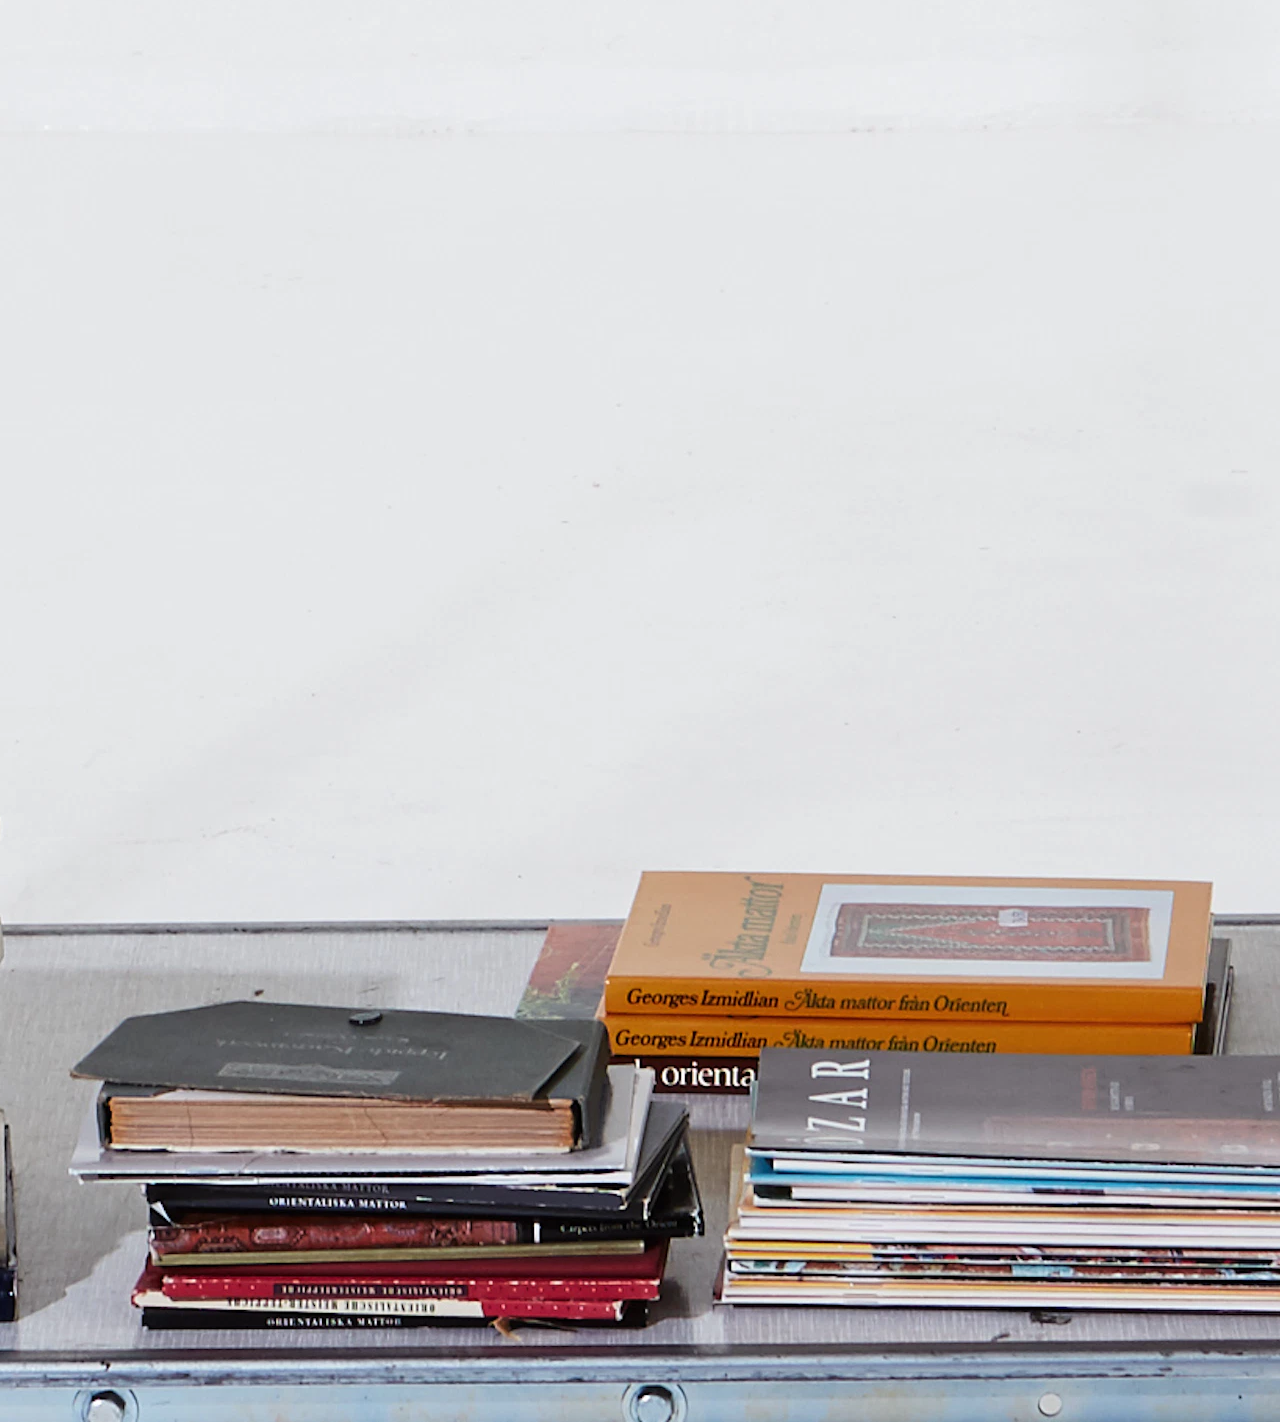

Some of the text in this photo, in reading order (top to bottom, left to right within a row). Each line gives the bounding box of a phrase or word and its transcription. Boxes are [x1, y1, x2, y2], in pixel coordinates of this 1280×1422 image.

[627, 988, 697, 1010] Georges
[702, 989, 780, 1009] Izmidlian
[784, 984, 836, 1012] Äkta
[840, 997, 894, 1012] mattor
[933, 997, 1009, 1017] Orienten
[269, 1197, 407, 1209] ORIENTALISKA MATTOR
